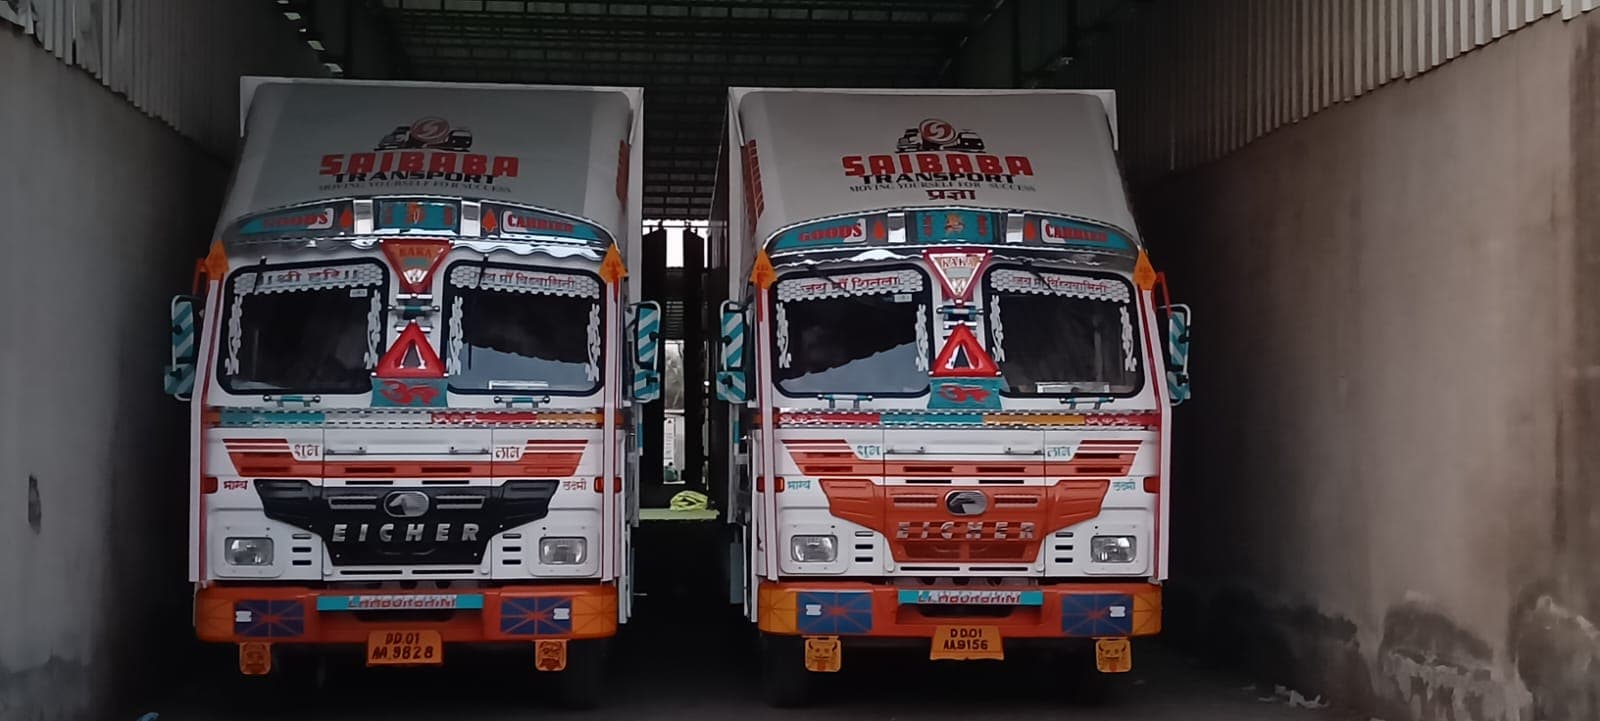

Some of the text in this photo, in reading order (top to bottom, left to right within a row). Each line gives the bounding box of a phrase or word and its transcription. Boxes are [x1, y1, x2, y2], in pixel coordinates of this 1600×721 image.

[317, 150, 519, 178] SAIBABA
[842, 153, 1034, 177] SAIBABA
[335, 171, 495, 185] TRANSPORT
[860, 172, 1016, 185] TRANSPORT
[850, 184, 896, 193] MOVING
[899, 181, 954, 189] YOURSELF
[957, 181, 981, 189] FOR
[798, 225, 863, 242] GOODS
[332, 523, 480, 542] EICHER
[895, 521, 1036, 539] EICHER
